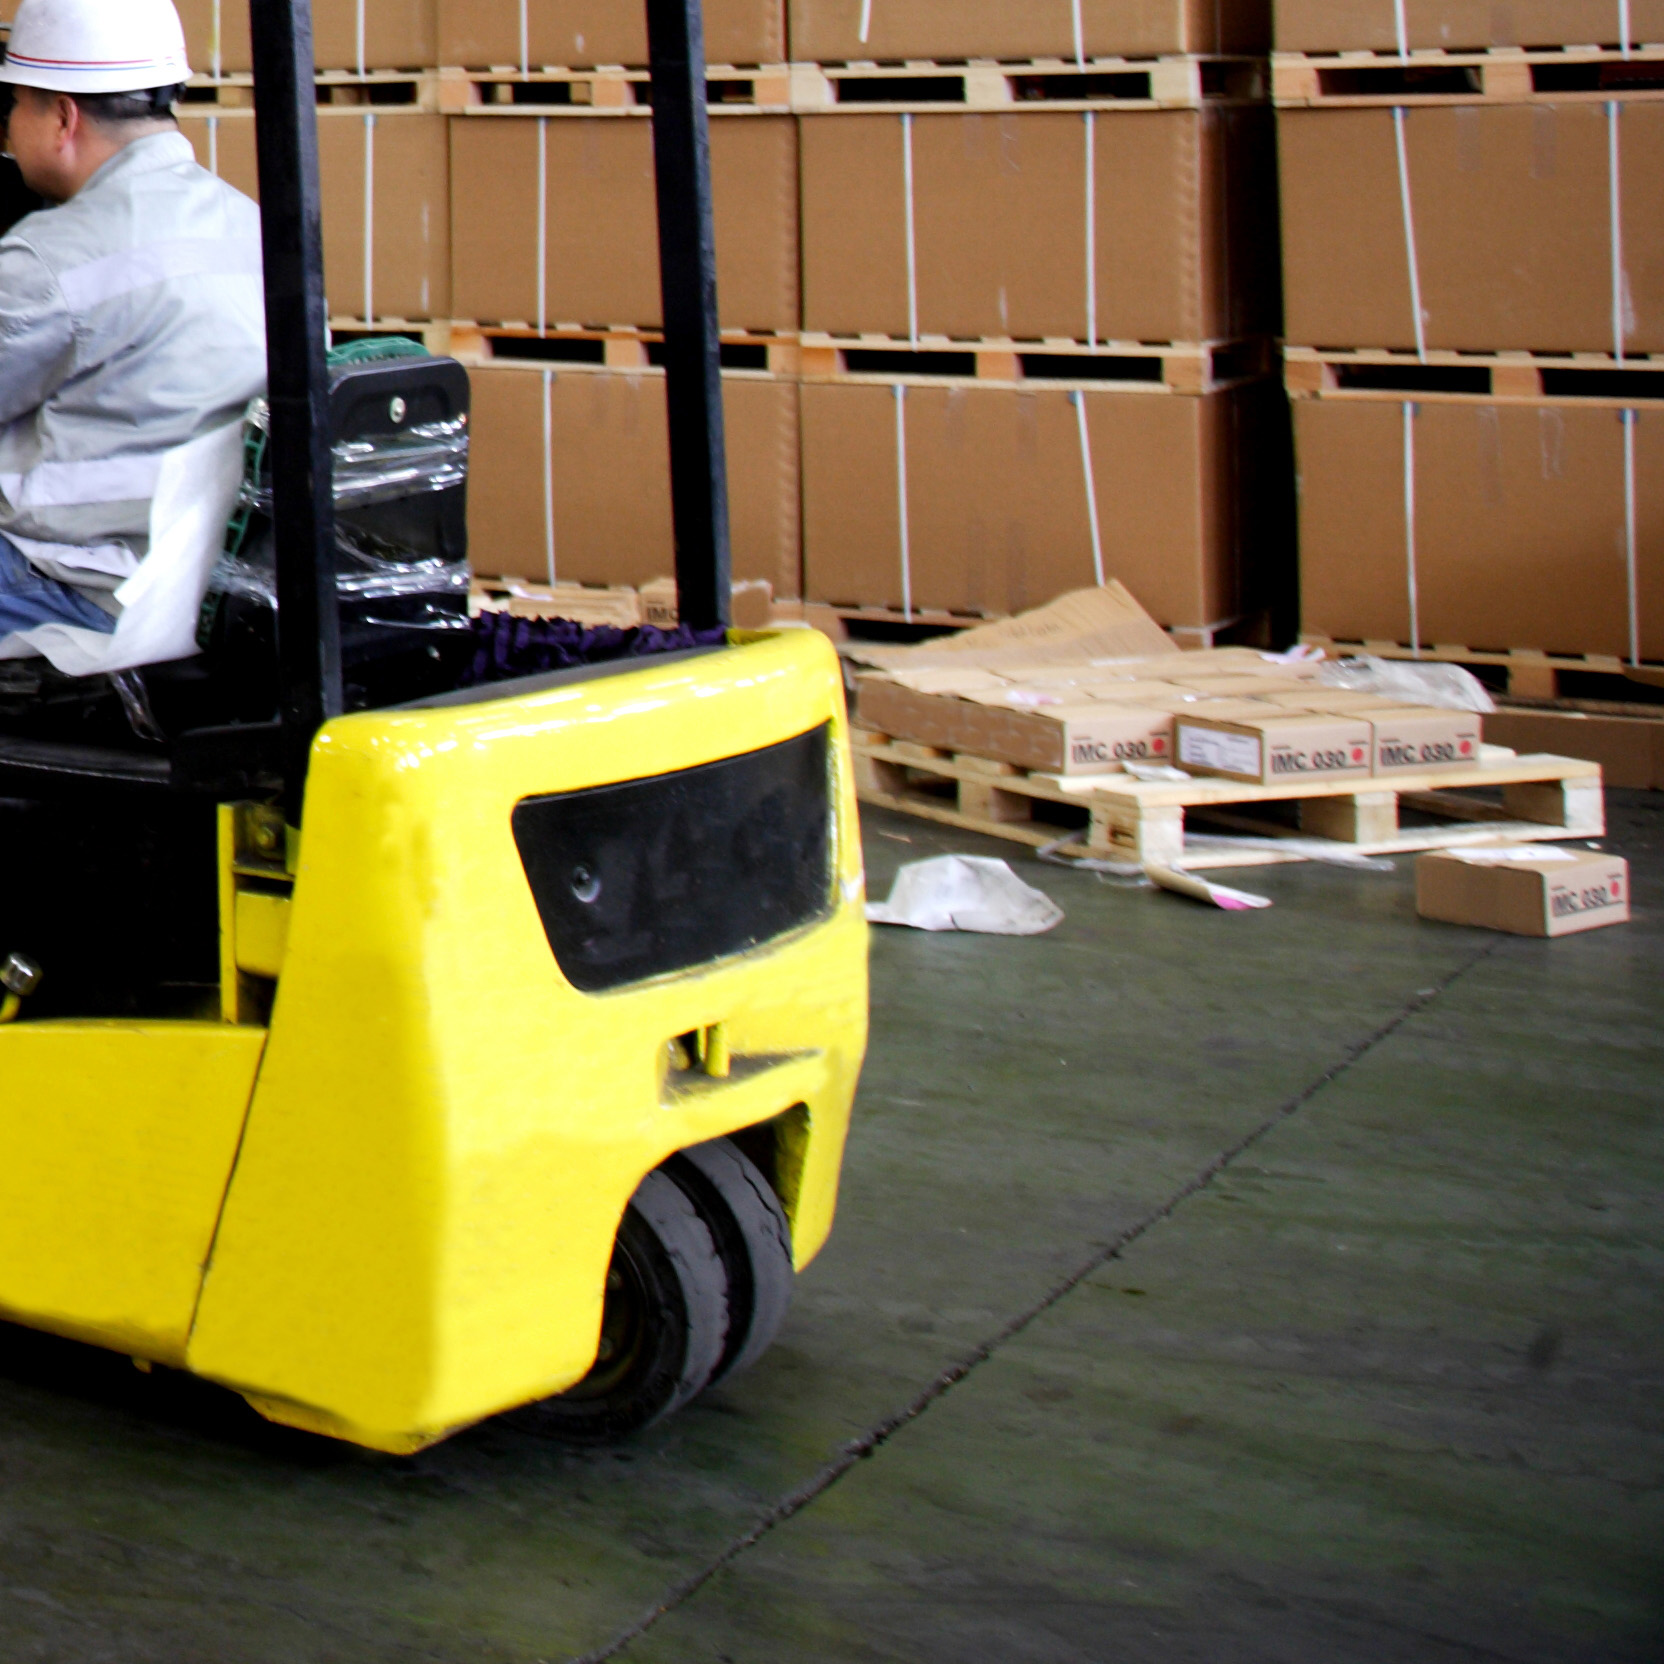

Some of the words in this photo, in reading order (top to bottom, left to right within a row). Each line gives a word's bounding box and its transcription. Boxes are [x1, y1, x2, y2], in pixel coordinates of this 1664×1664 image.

[1072, 742, 1108, 763] IMC
[1113, 741, 1148, 758] 030
[1271, 750, 1307, 773] IMC
[1312, 749, 1346, 769] 030
[1378, 743, 1415, 766] IMC
[1419, 741, 1454, 762] 030
[1550, 890, 1577, 917] IMC
